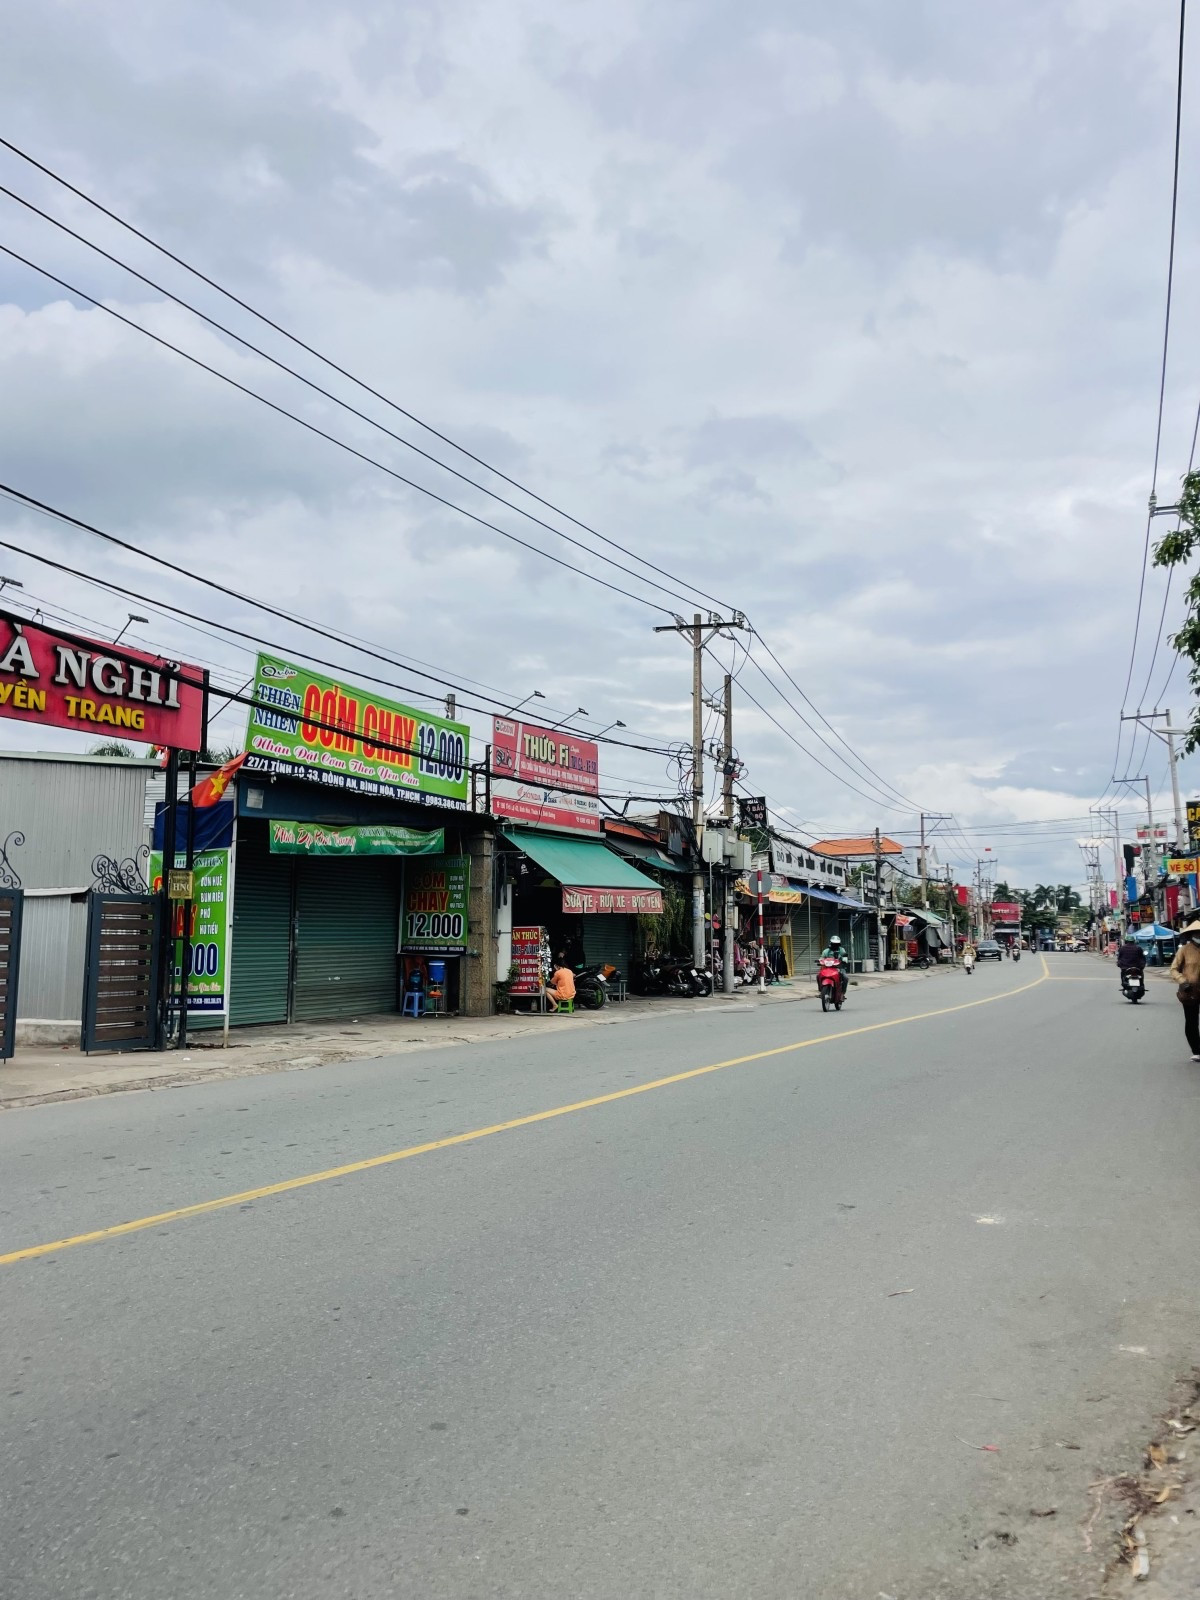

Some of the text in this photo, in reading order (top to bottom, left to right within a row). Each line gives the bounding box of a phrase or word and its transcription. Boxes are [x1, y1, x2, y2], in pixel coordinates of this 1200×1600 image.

[55, 645, 181, 708] NGHỈ
[65, 695, 145, 730] TRANG
[259, 683, 301, 711] THIÊN
[302, 683, 415, 768] CƠM CHAY
[252, 735, 291, 757] Nhận
[321, 752, 346, 769] Cơm
[349, 759, 375, 776] Theo
[377, 766, 398, 784] Yêu
[418, 723, 464, 782] 12.000
[523, 733, 556, 765] THỨC
[407, 891, 449, 912] CHAY
[616, 895, 625, 907] XE
[406, 913, 464, 939] 12.000
